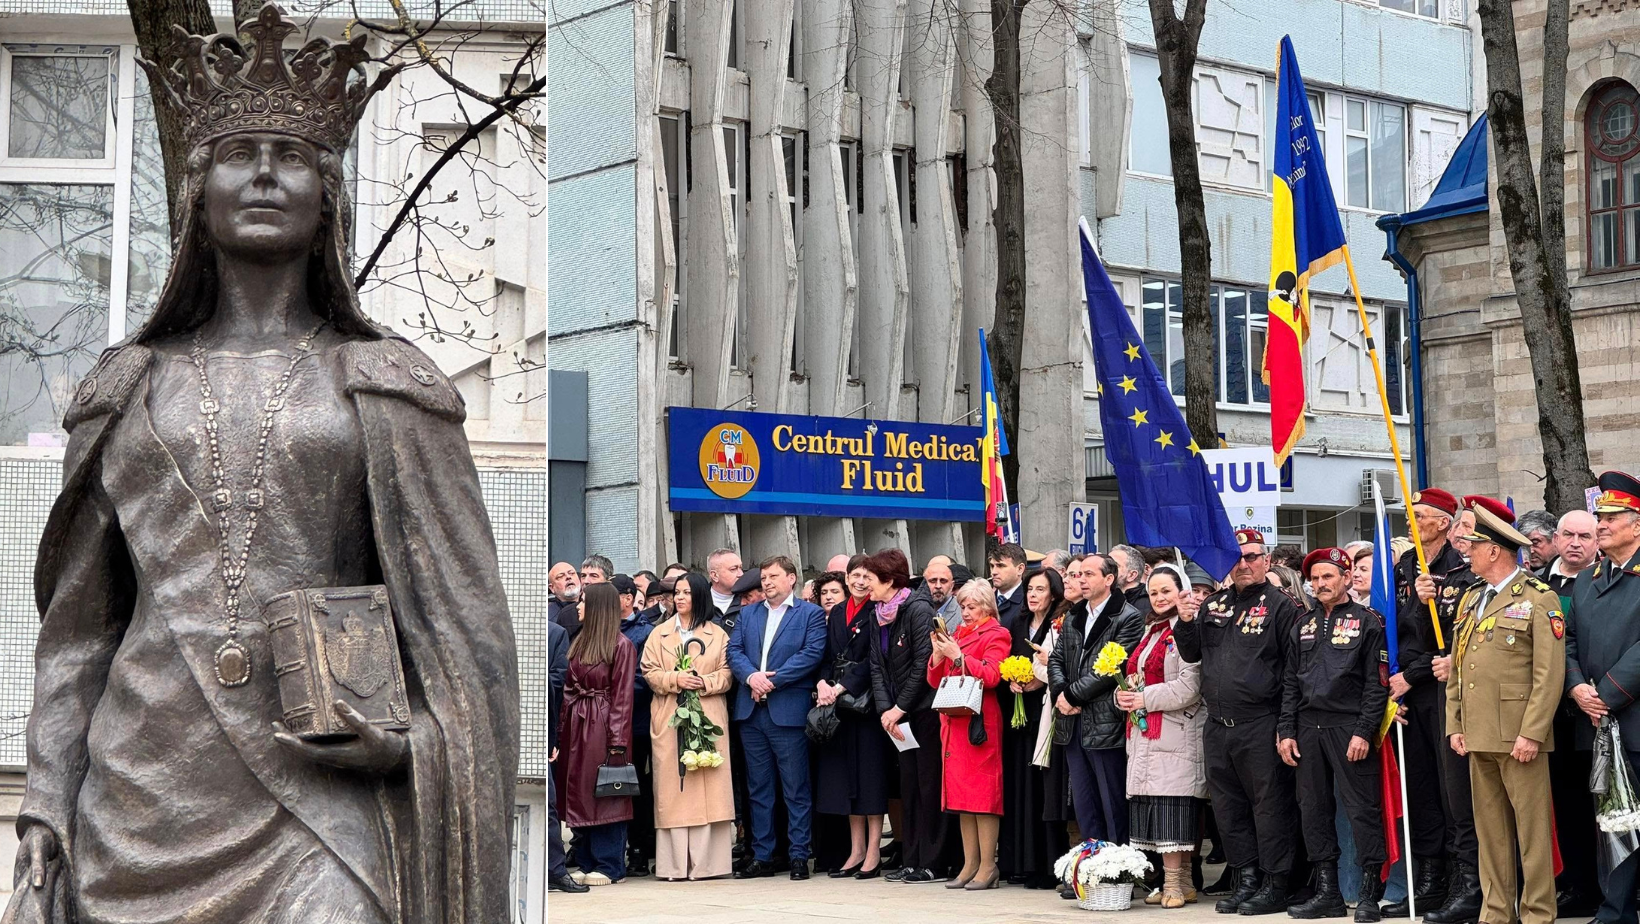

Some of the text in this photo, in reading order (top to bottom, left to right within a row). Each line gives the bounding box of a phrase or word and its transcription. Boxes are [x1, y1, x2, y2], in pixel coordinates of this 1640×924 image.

[1291, 135, 1311, 156] 1992
[720, 429, 742, 445] CM
[772, 424, 875, 457] Centrul
[840, 459, 926, 493] Fluid
